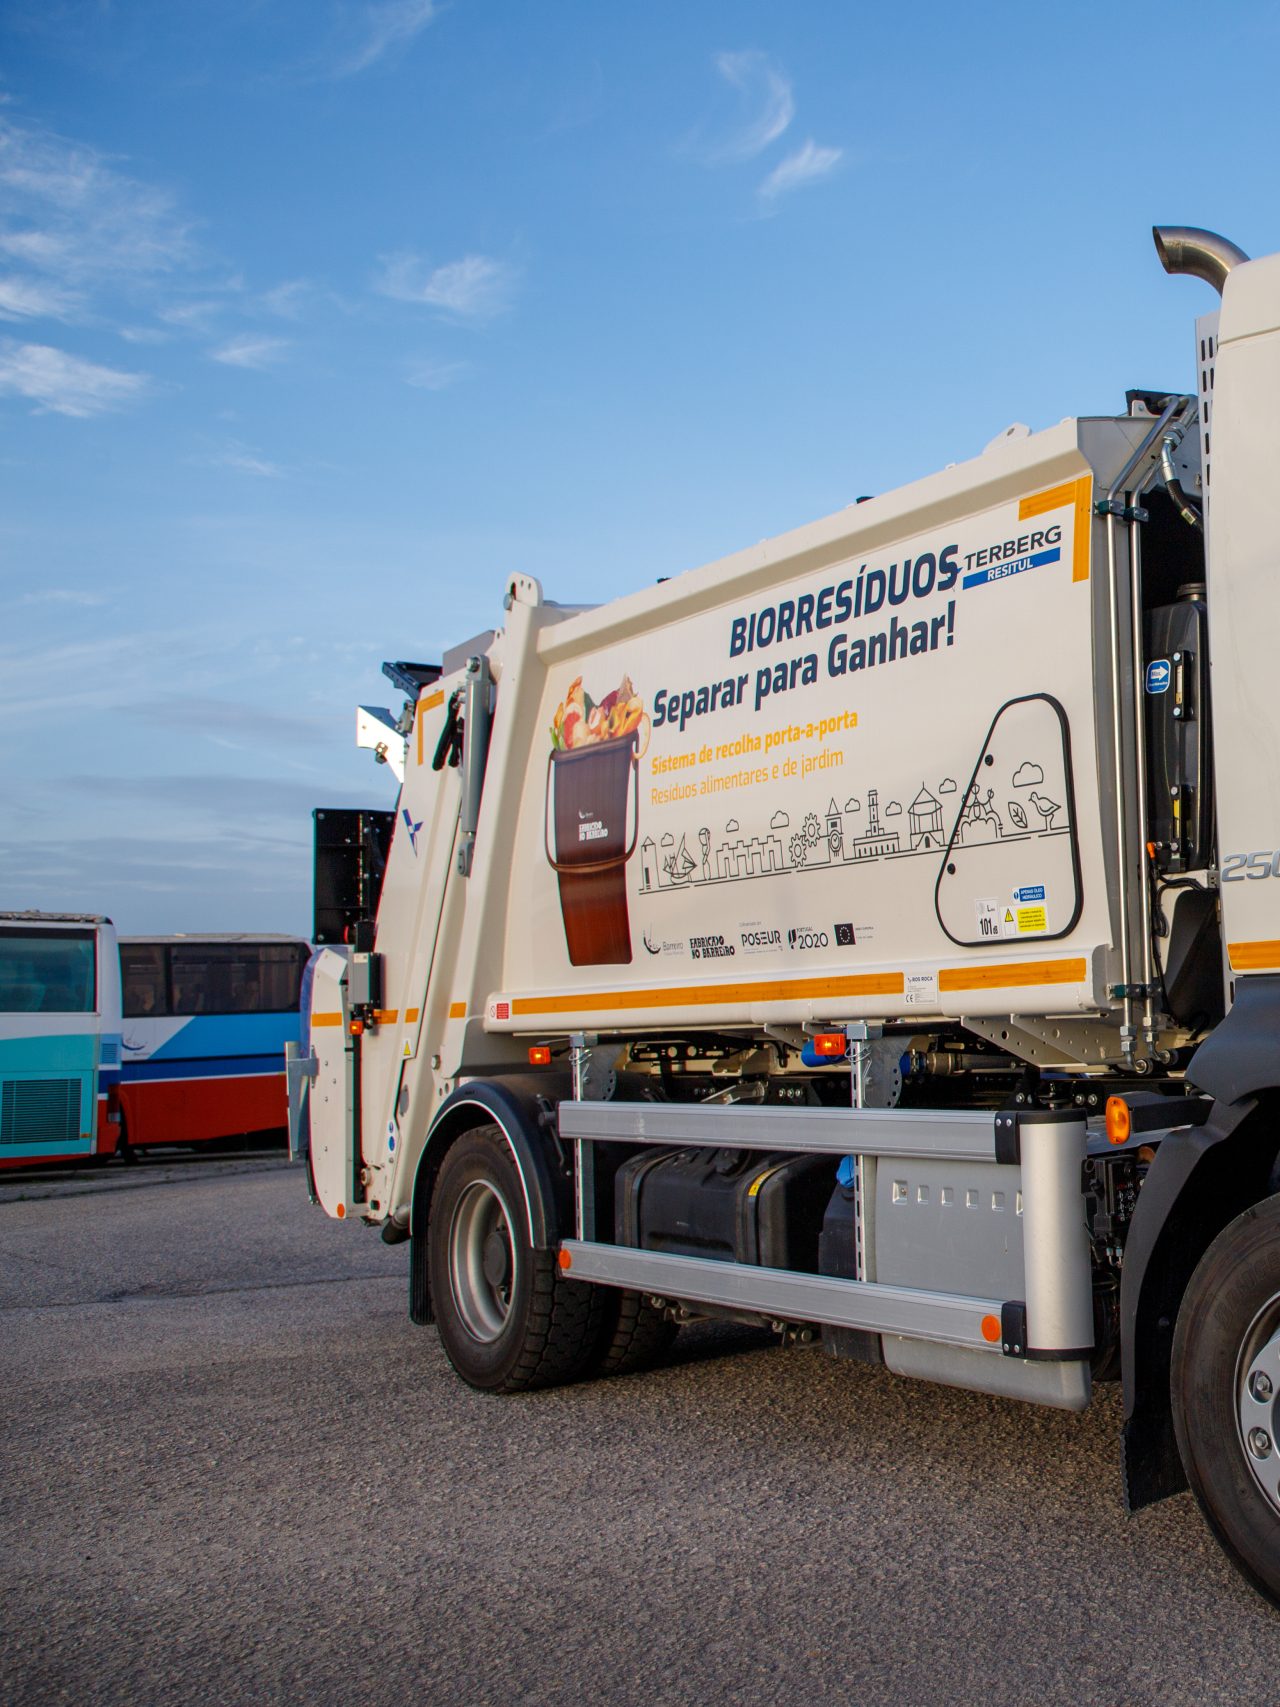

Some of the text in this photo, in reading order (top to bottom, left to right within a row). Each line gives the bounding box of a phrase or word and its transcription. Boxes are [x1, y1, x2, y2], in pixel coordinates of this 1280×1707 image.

[964, 525, 1062, 571] TERBERG
[987, 558, 1033, 581] RESITUL
[729, 544, 959, 658] BIORRESÍDUOS
[652, 600, 956, 732] Separar para Ganhar!
[651, 710, 859, 776] Sistema de recolha porta-a-porta
[651, 747, 844, 806] Resíduos alimentares e de jardim
[741, 930, 782, 947] POSEUR
[798, 932, 829, 950] 2020
[980, 918, 993, 935] 101
